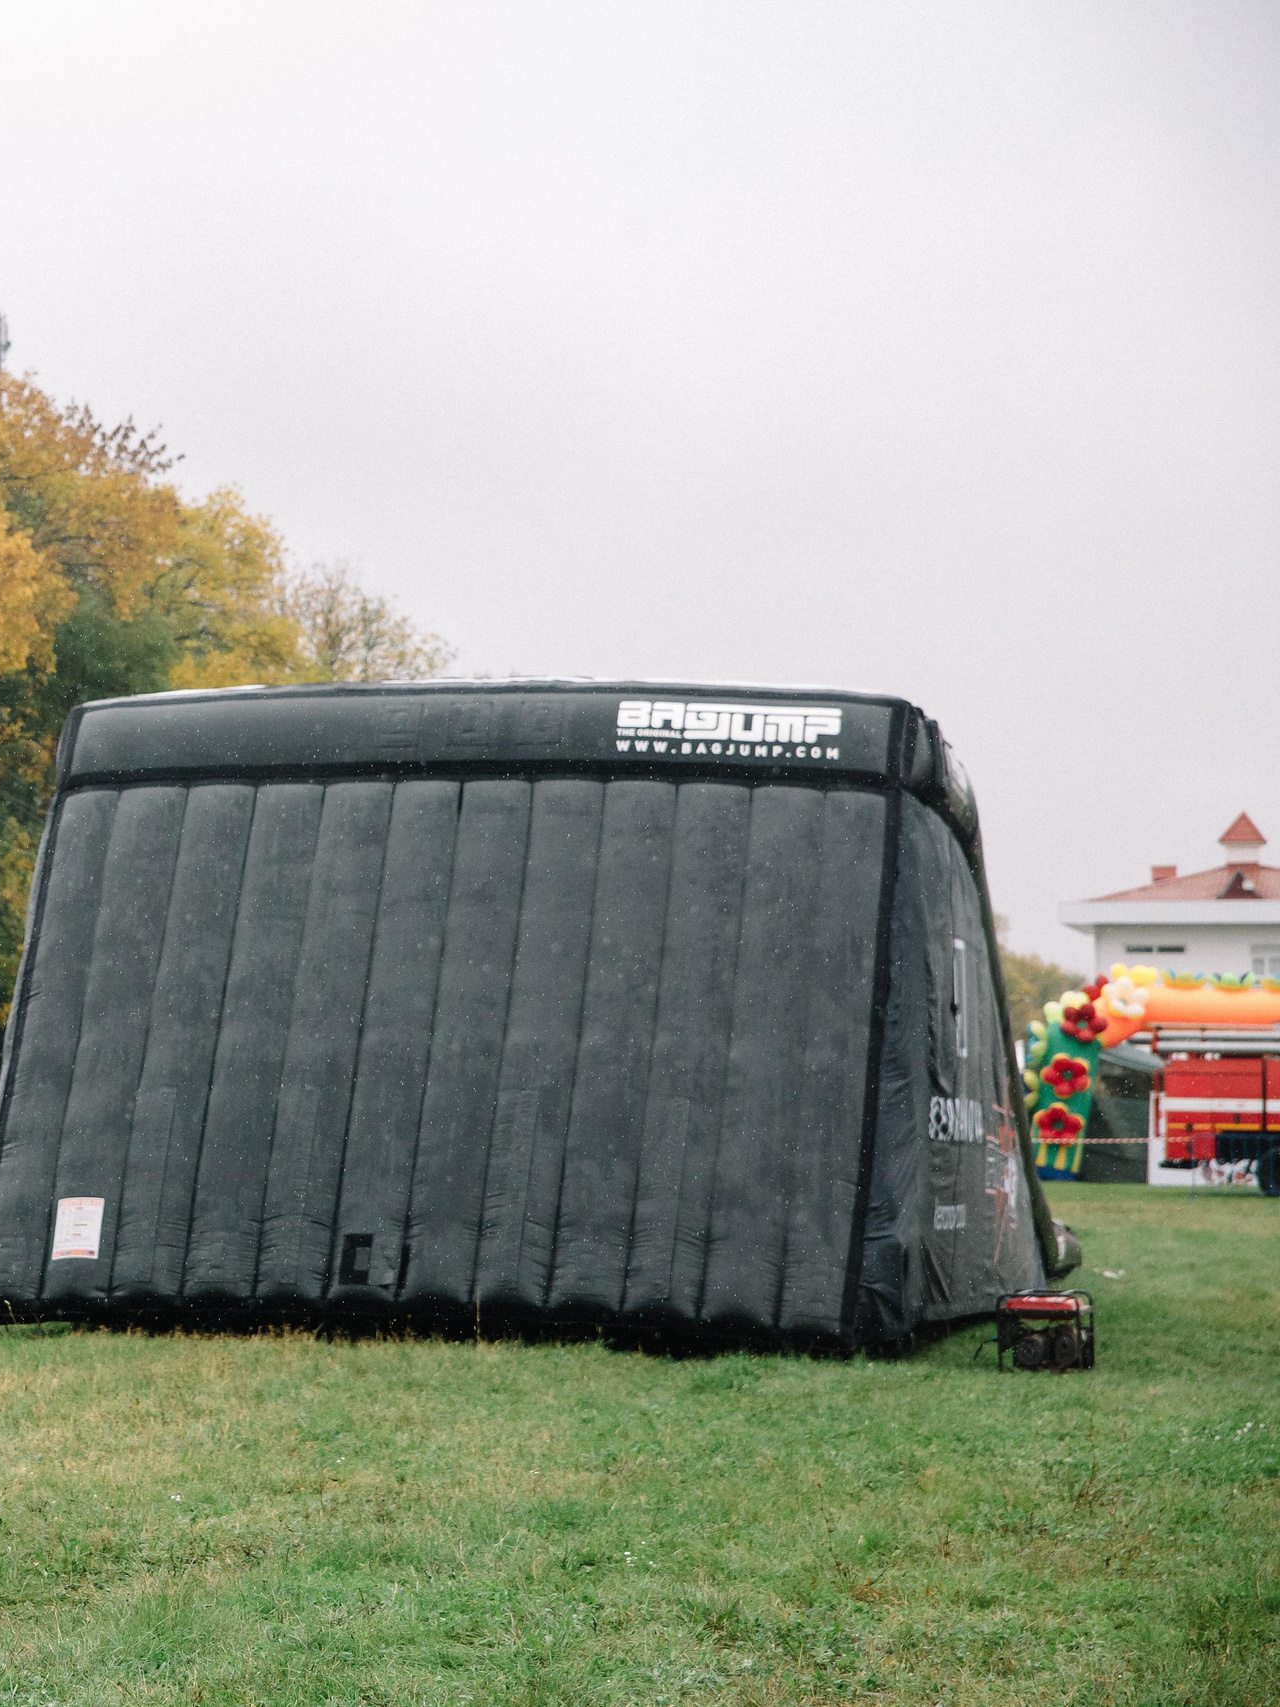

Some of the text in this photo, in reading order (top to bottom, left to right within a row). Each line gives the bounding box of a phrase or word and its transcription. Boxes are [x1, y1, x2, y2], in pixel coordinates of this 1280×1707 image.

[617, 700, 843, 744] BAGJUMP
[616, 728, 683, 739] THE ORIGINAL
[616, 740, 840, 761] WWW.BAGJUMP.COM
